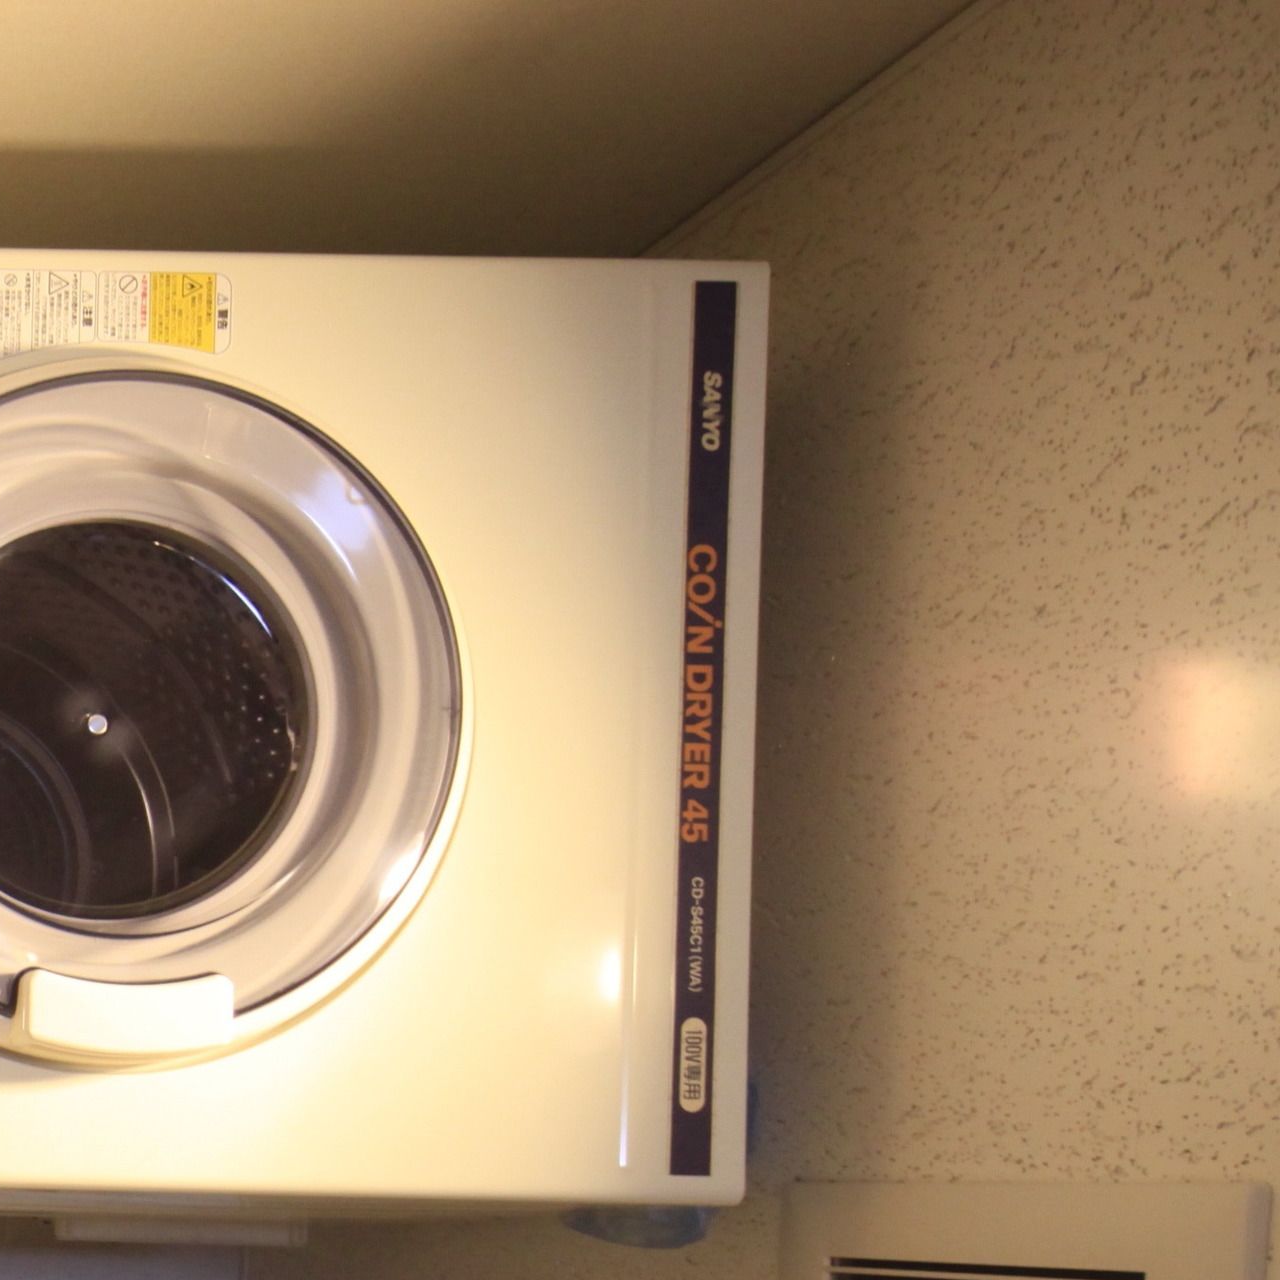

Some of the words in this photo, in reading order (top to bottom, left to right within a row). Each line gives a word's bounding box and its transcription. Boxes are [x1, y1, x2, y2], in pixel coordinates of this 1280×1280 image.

[82, 306, 93, 327] 注意
[701, 371, 723, 451] SANYO
[682, 664, 713, 789] DRYER
[681, 799, 709, 842] 45
[686, 876, 705, 993] CD-S45C1(WA)
[683, 1030, 704, 1100] 100V専用
